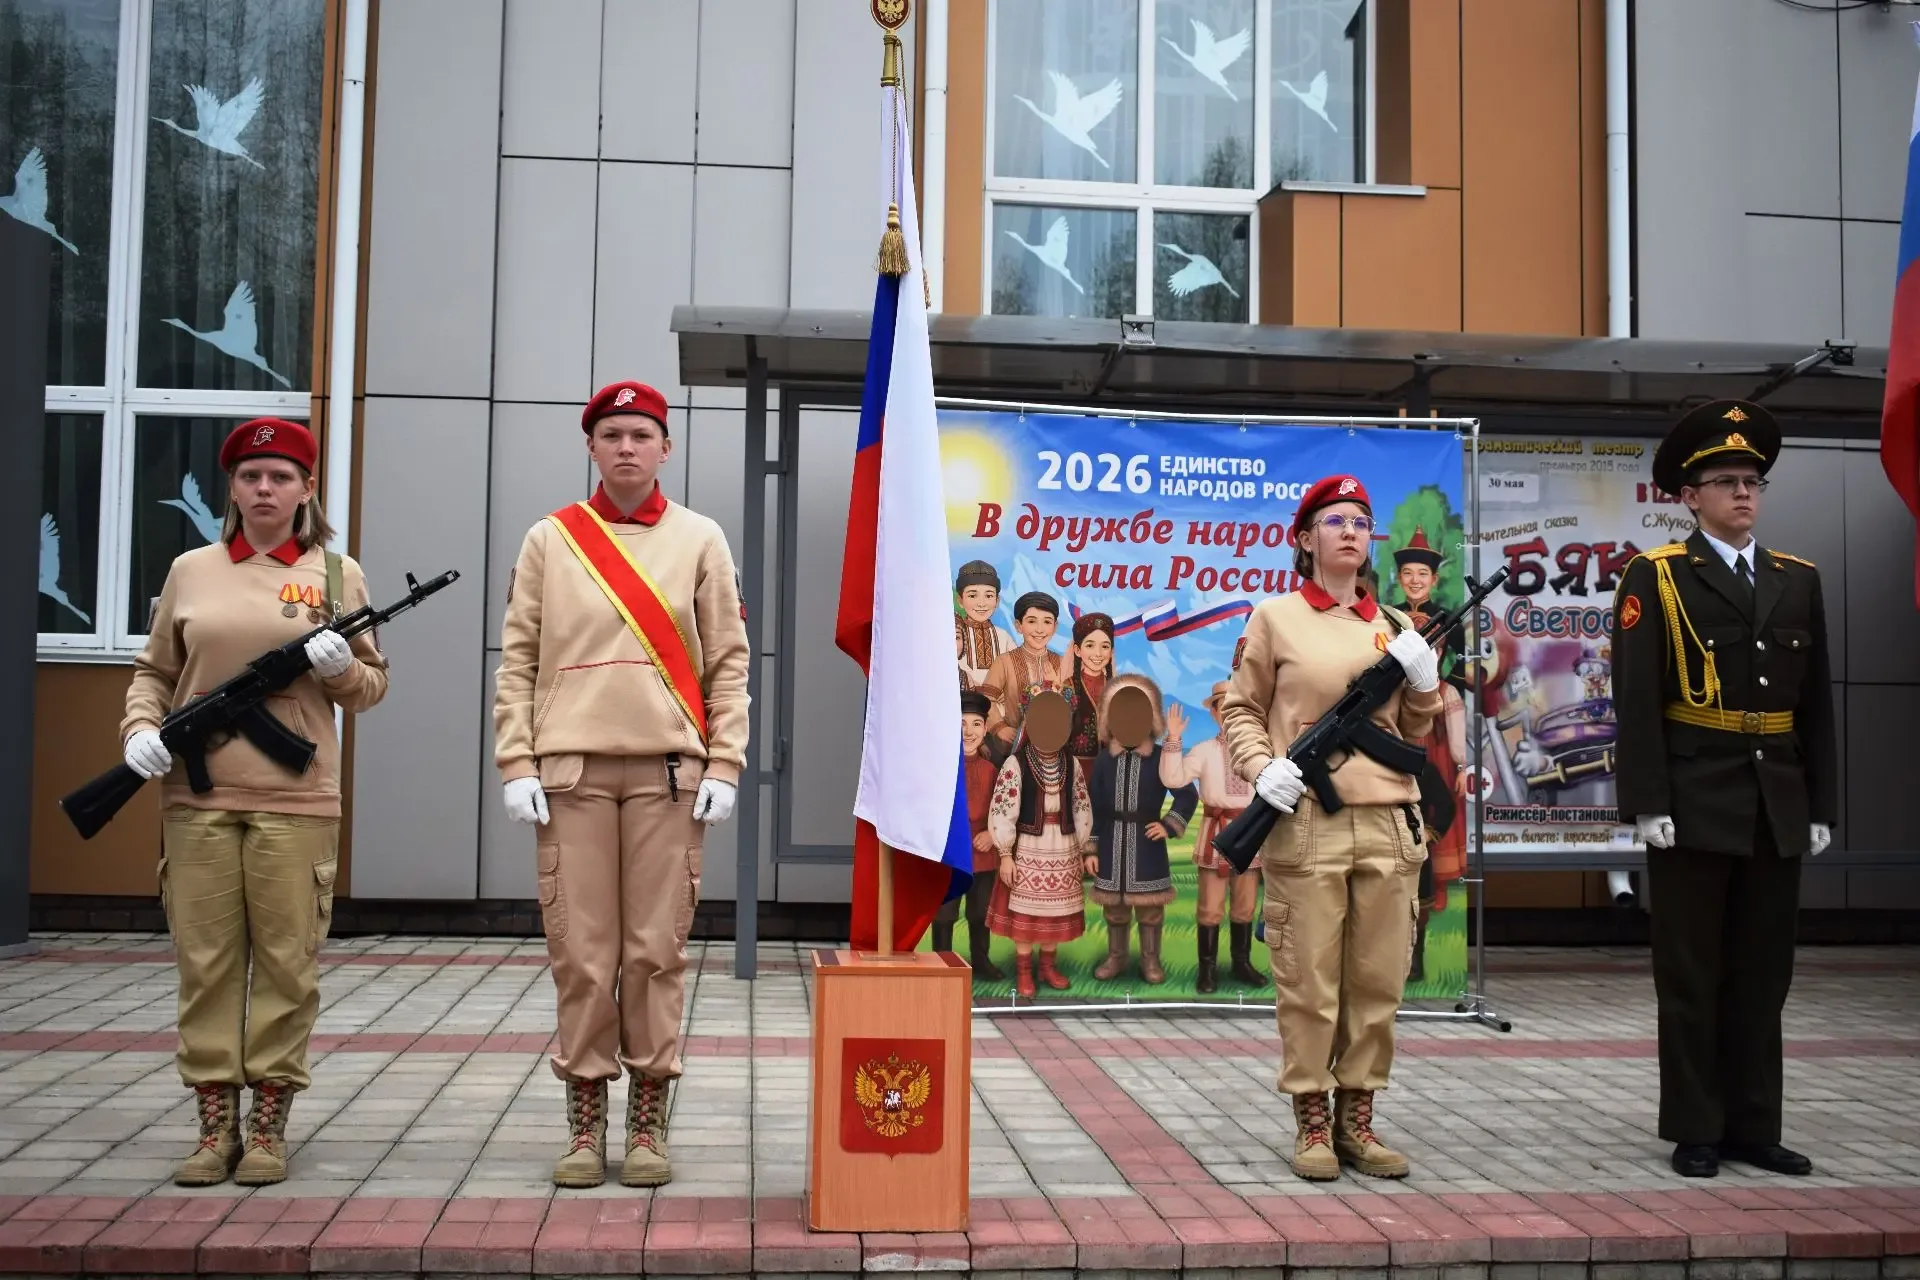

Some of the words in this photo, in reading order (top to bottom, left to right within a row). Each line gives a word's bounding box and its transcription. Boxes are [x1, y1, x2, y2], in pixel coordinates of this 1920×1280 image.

[1037, 450, 1152, 494] 2026
[1159, 454, 1266, 478] ЕДИНСТВО
[1488, 478, 1501, 488] 30
[1504, 479, 1525, 488] мая
[1159, 478, 1257, 501] НАРОДОВ
[1263, 481, 1313, 500] РОСС
[971, 502, 1003, 538] В
[1015, 503, 1174, 552] дружбе
[1544, 516, 1579, 530] сказка
[1055, 559, 1153, 591] сила
[1502, 535, 1644, 597] БЯК
[1485, 806, 1619, 823] Режиссёр-постановщ
